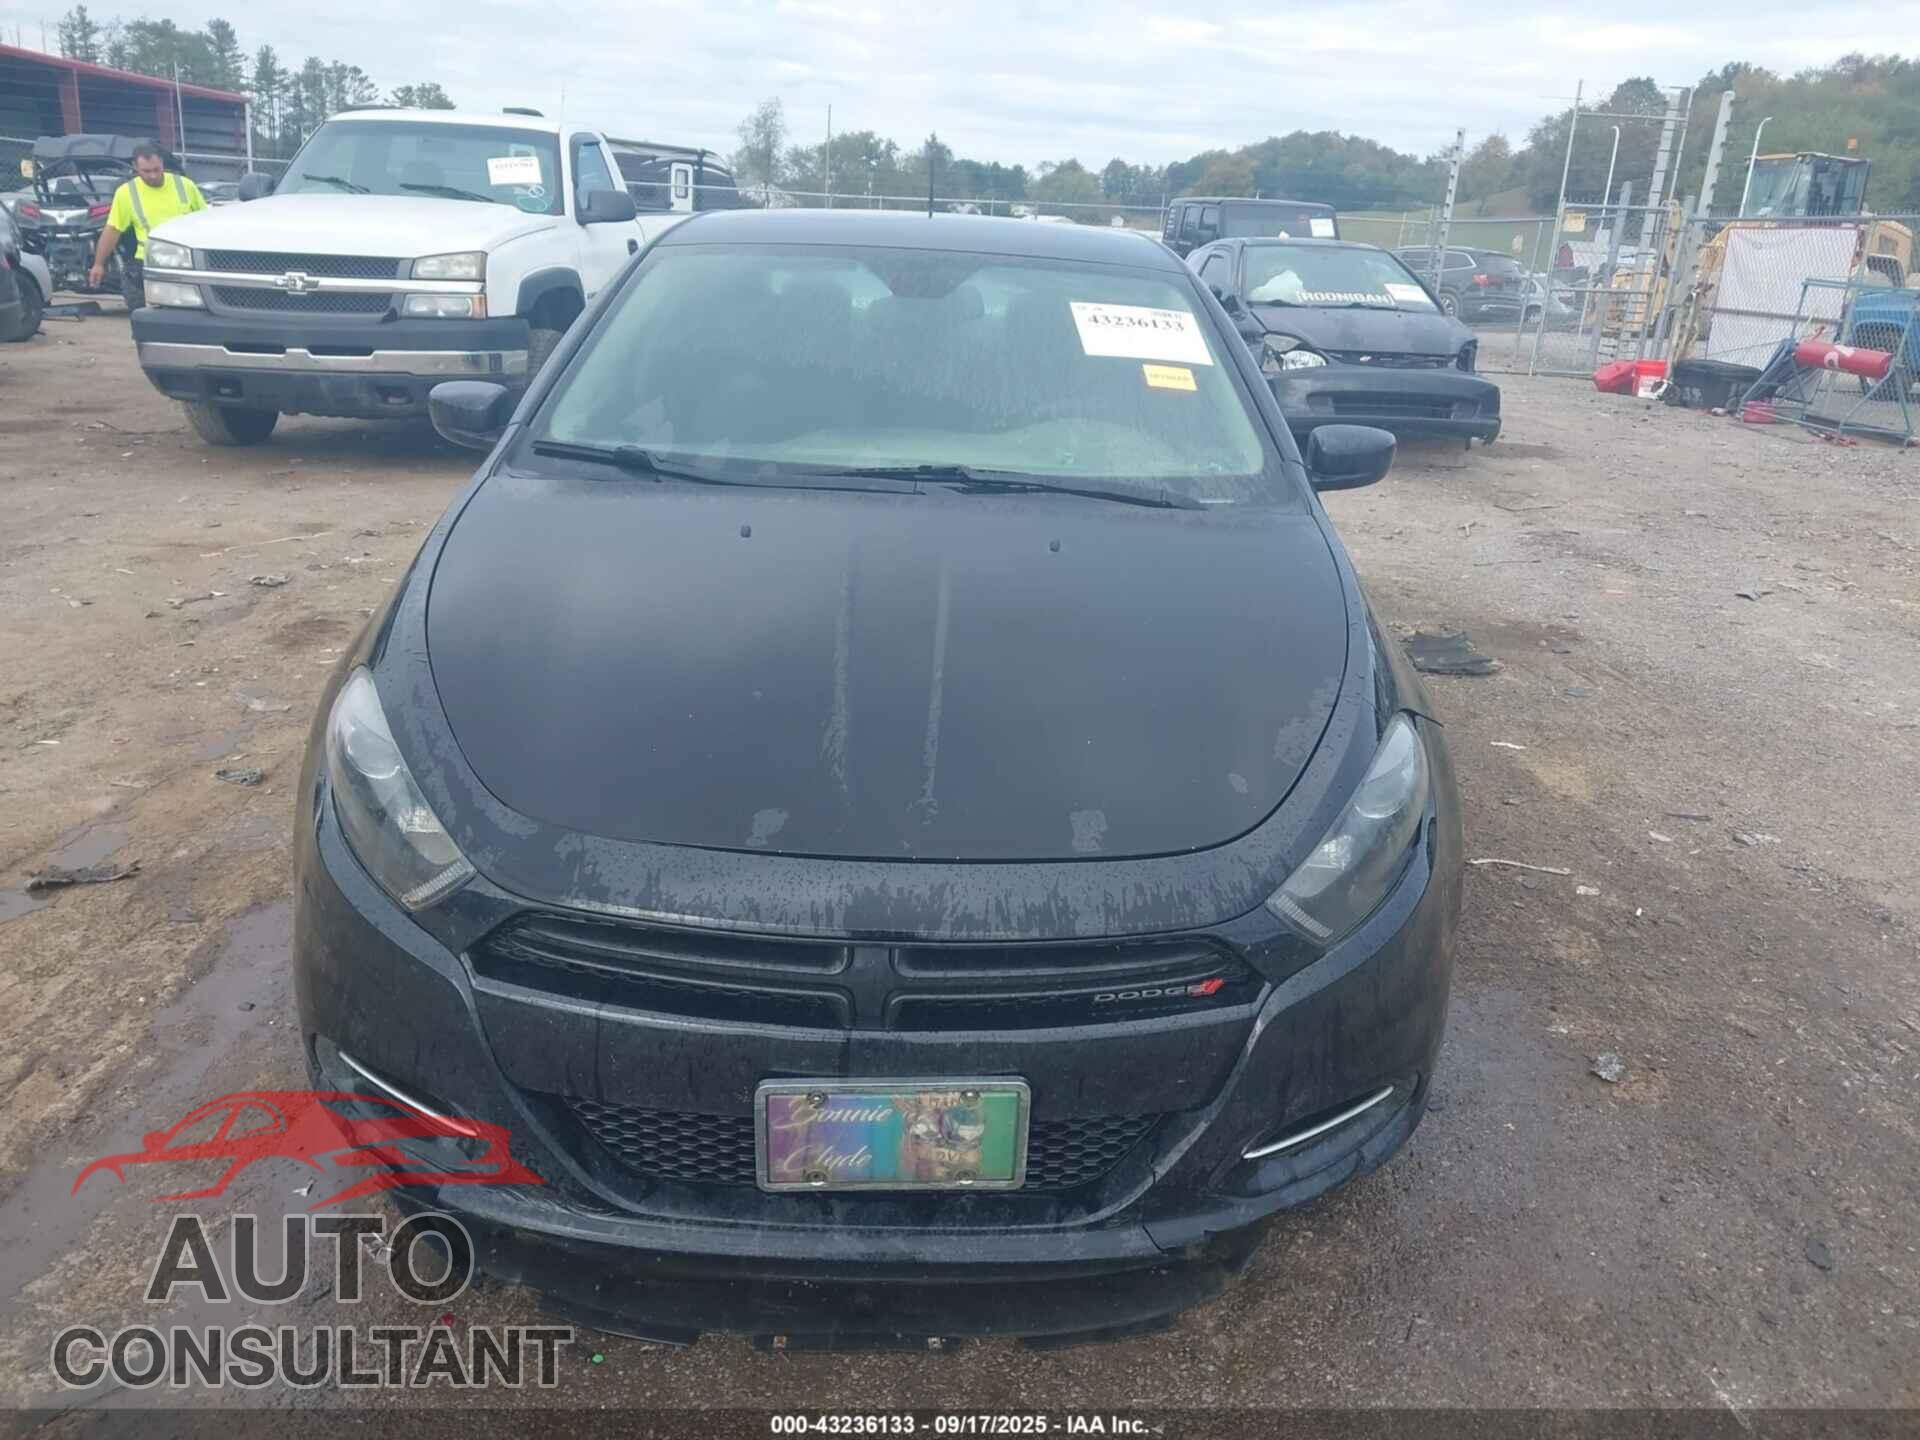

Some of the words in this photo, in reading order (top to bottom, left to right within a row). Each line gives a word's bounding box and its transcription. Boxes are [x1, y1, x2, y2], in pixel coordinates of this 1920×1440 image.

[1088, 313, 1185, 332] 43236133
[1092, 984, 1204, 1001] DODGE
[773, 1096, 893, 1130] Bonnie
[784, 1144, 873, 1173] Clyde
